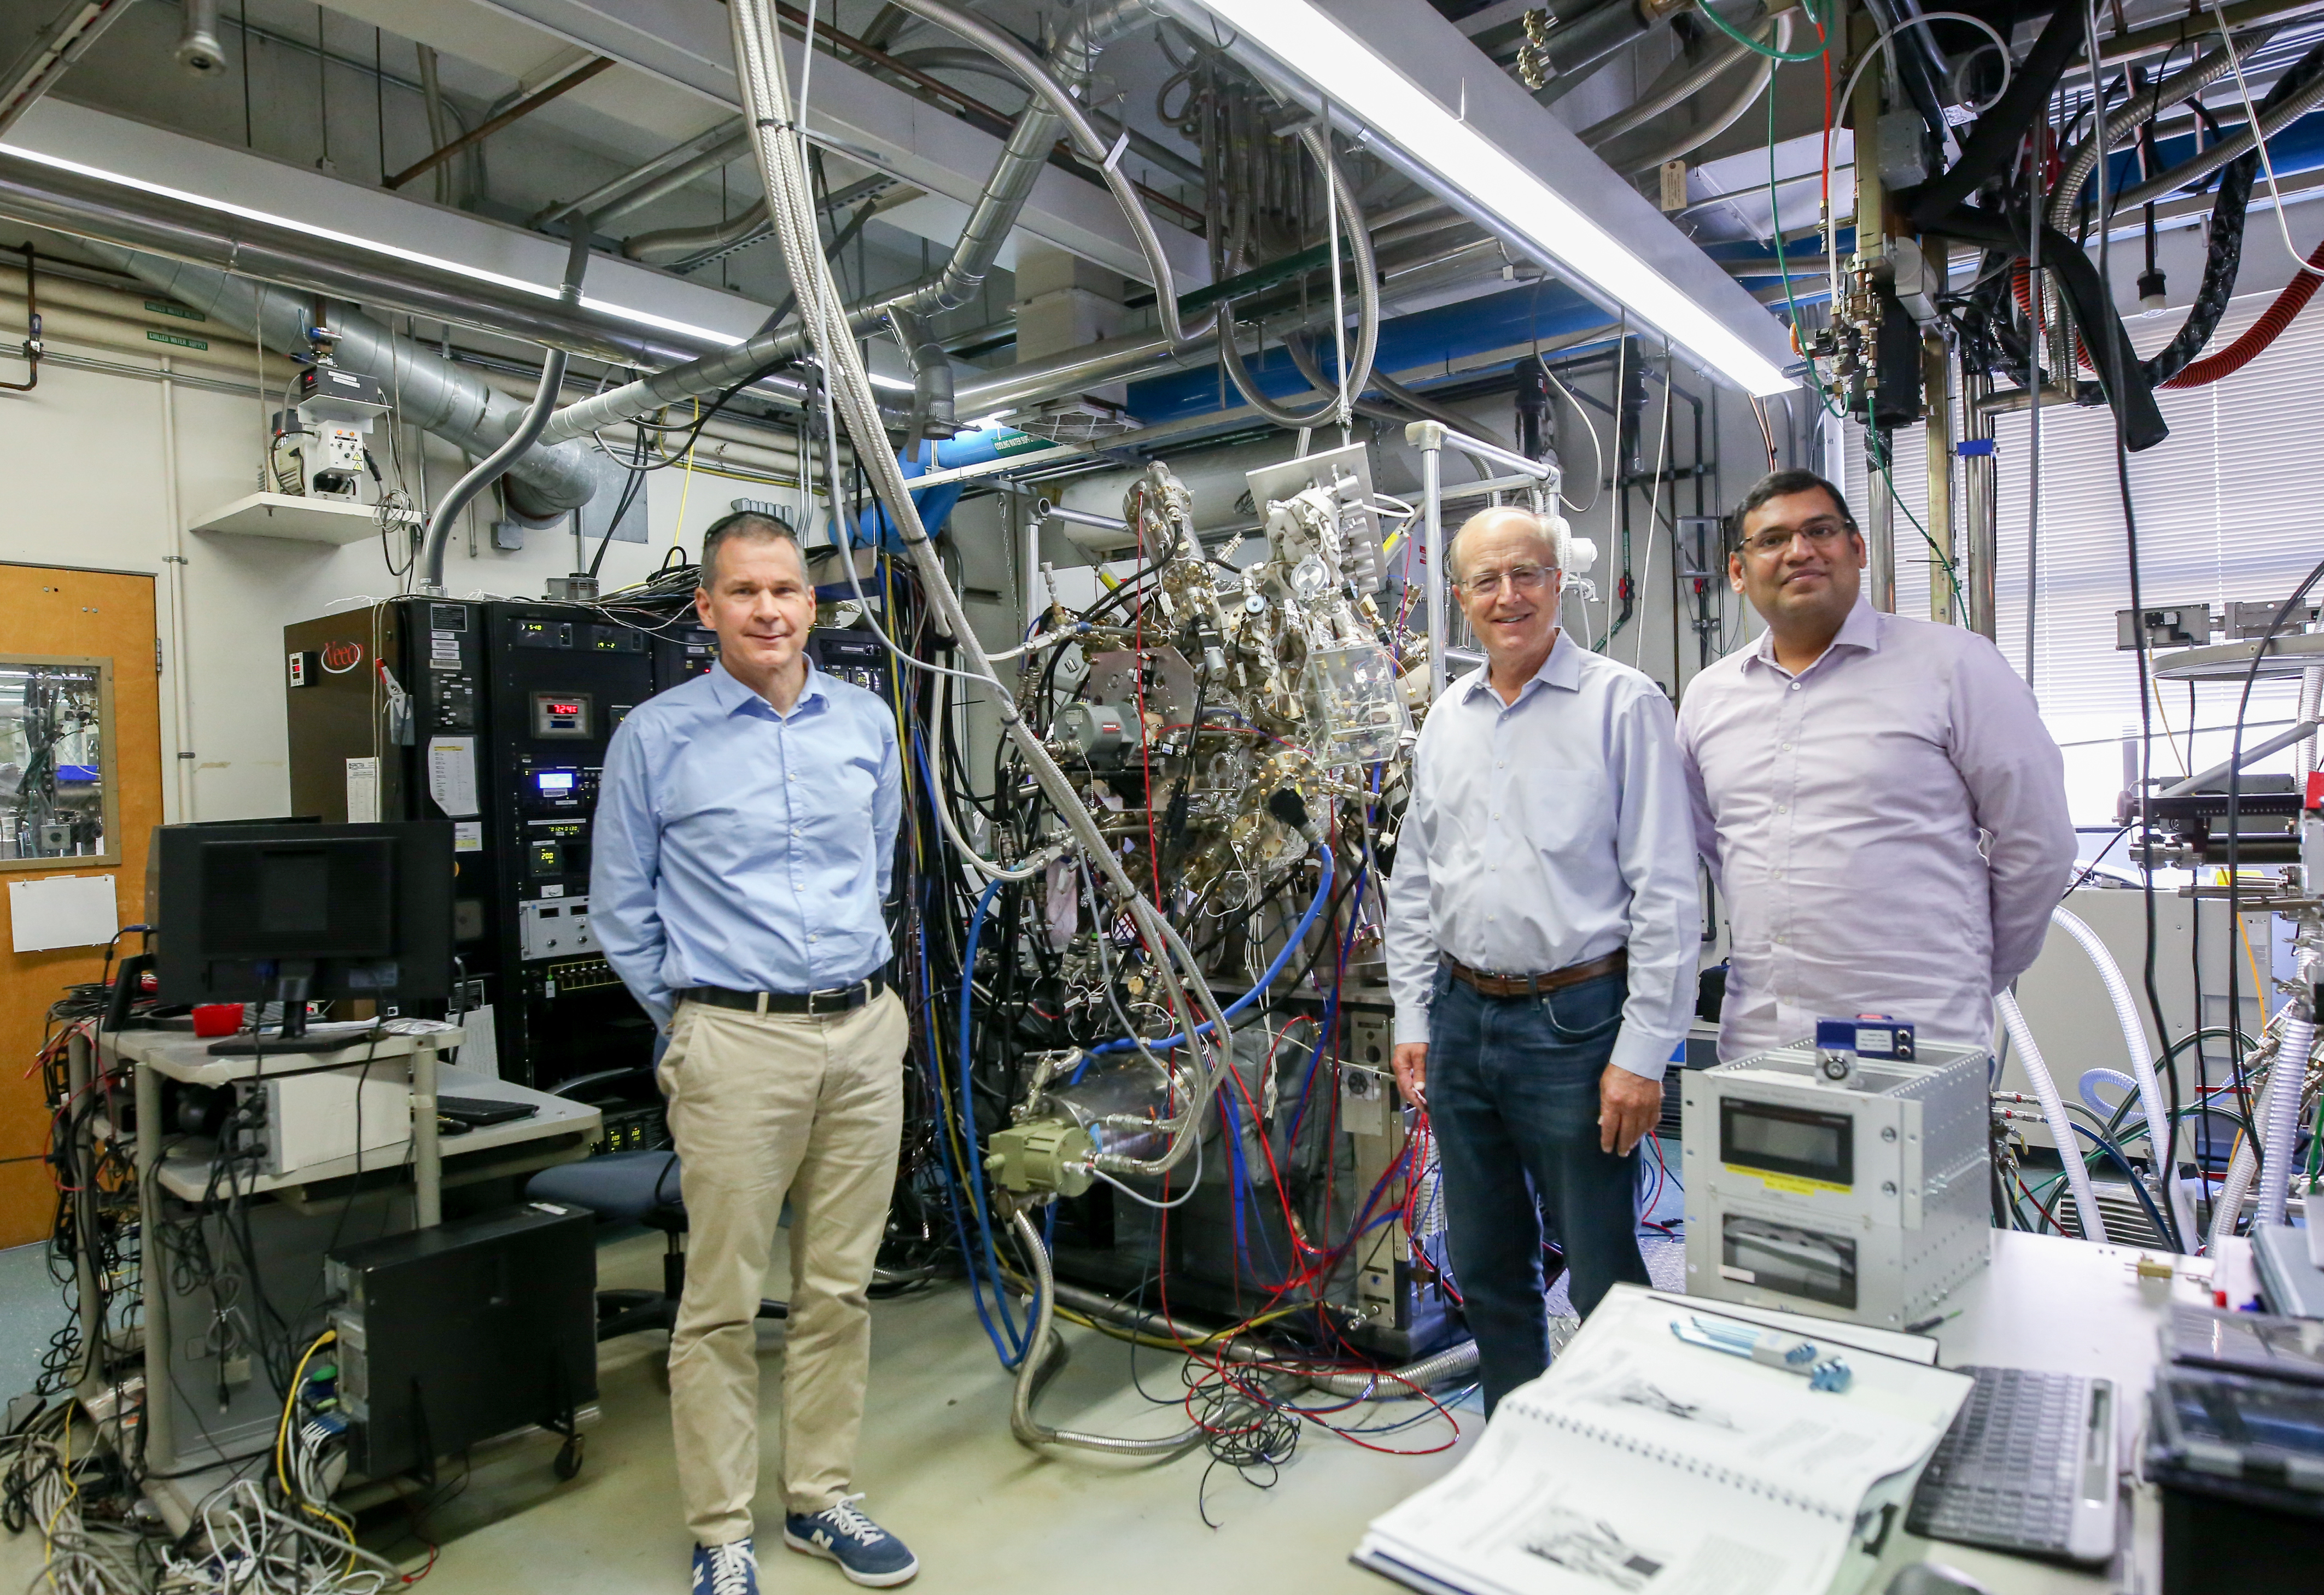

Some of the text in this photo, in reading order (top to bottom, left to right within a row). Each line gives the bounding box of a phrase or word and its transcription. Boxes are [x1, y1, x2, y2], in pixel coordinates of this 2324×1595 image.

[149, 332, 206, 349] CHILLED WATER SUPPLY
[994, 440, 1011, 450] COOLING
[1009, 437, 1022, 447] WATER
[324, 641, 364, 667] Veeco
